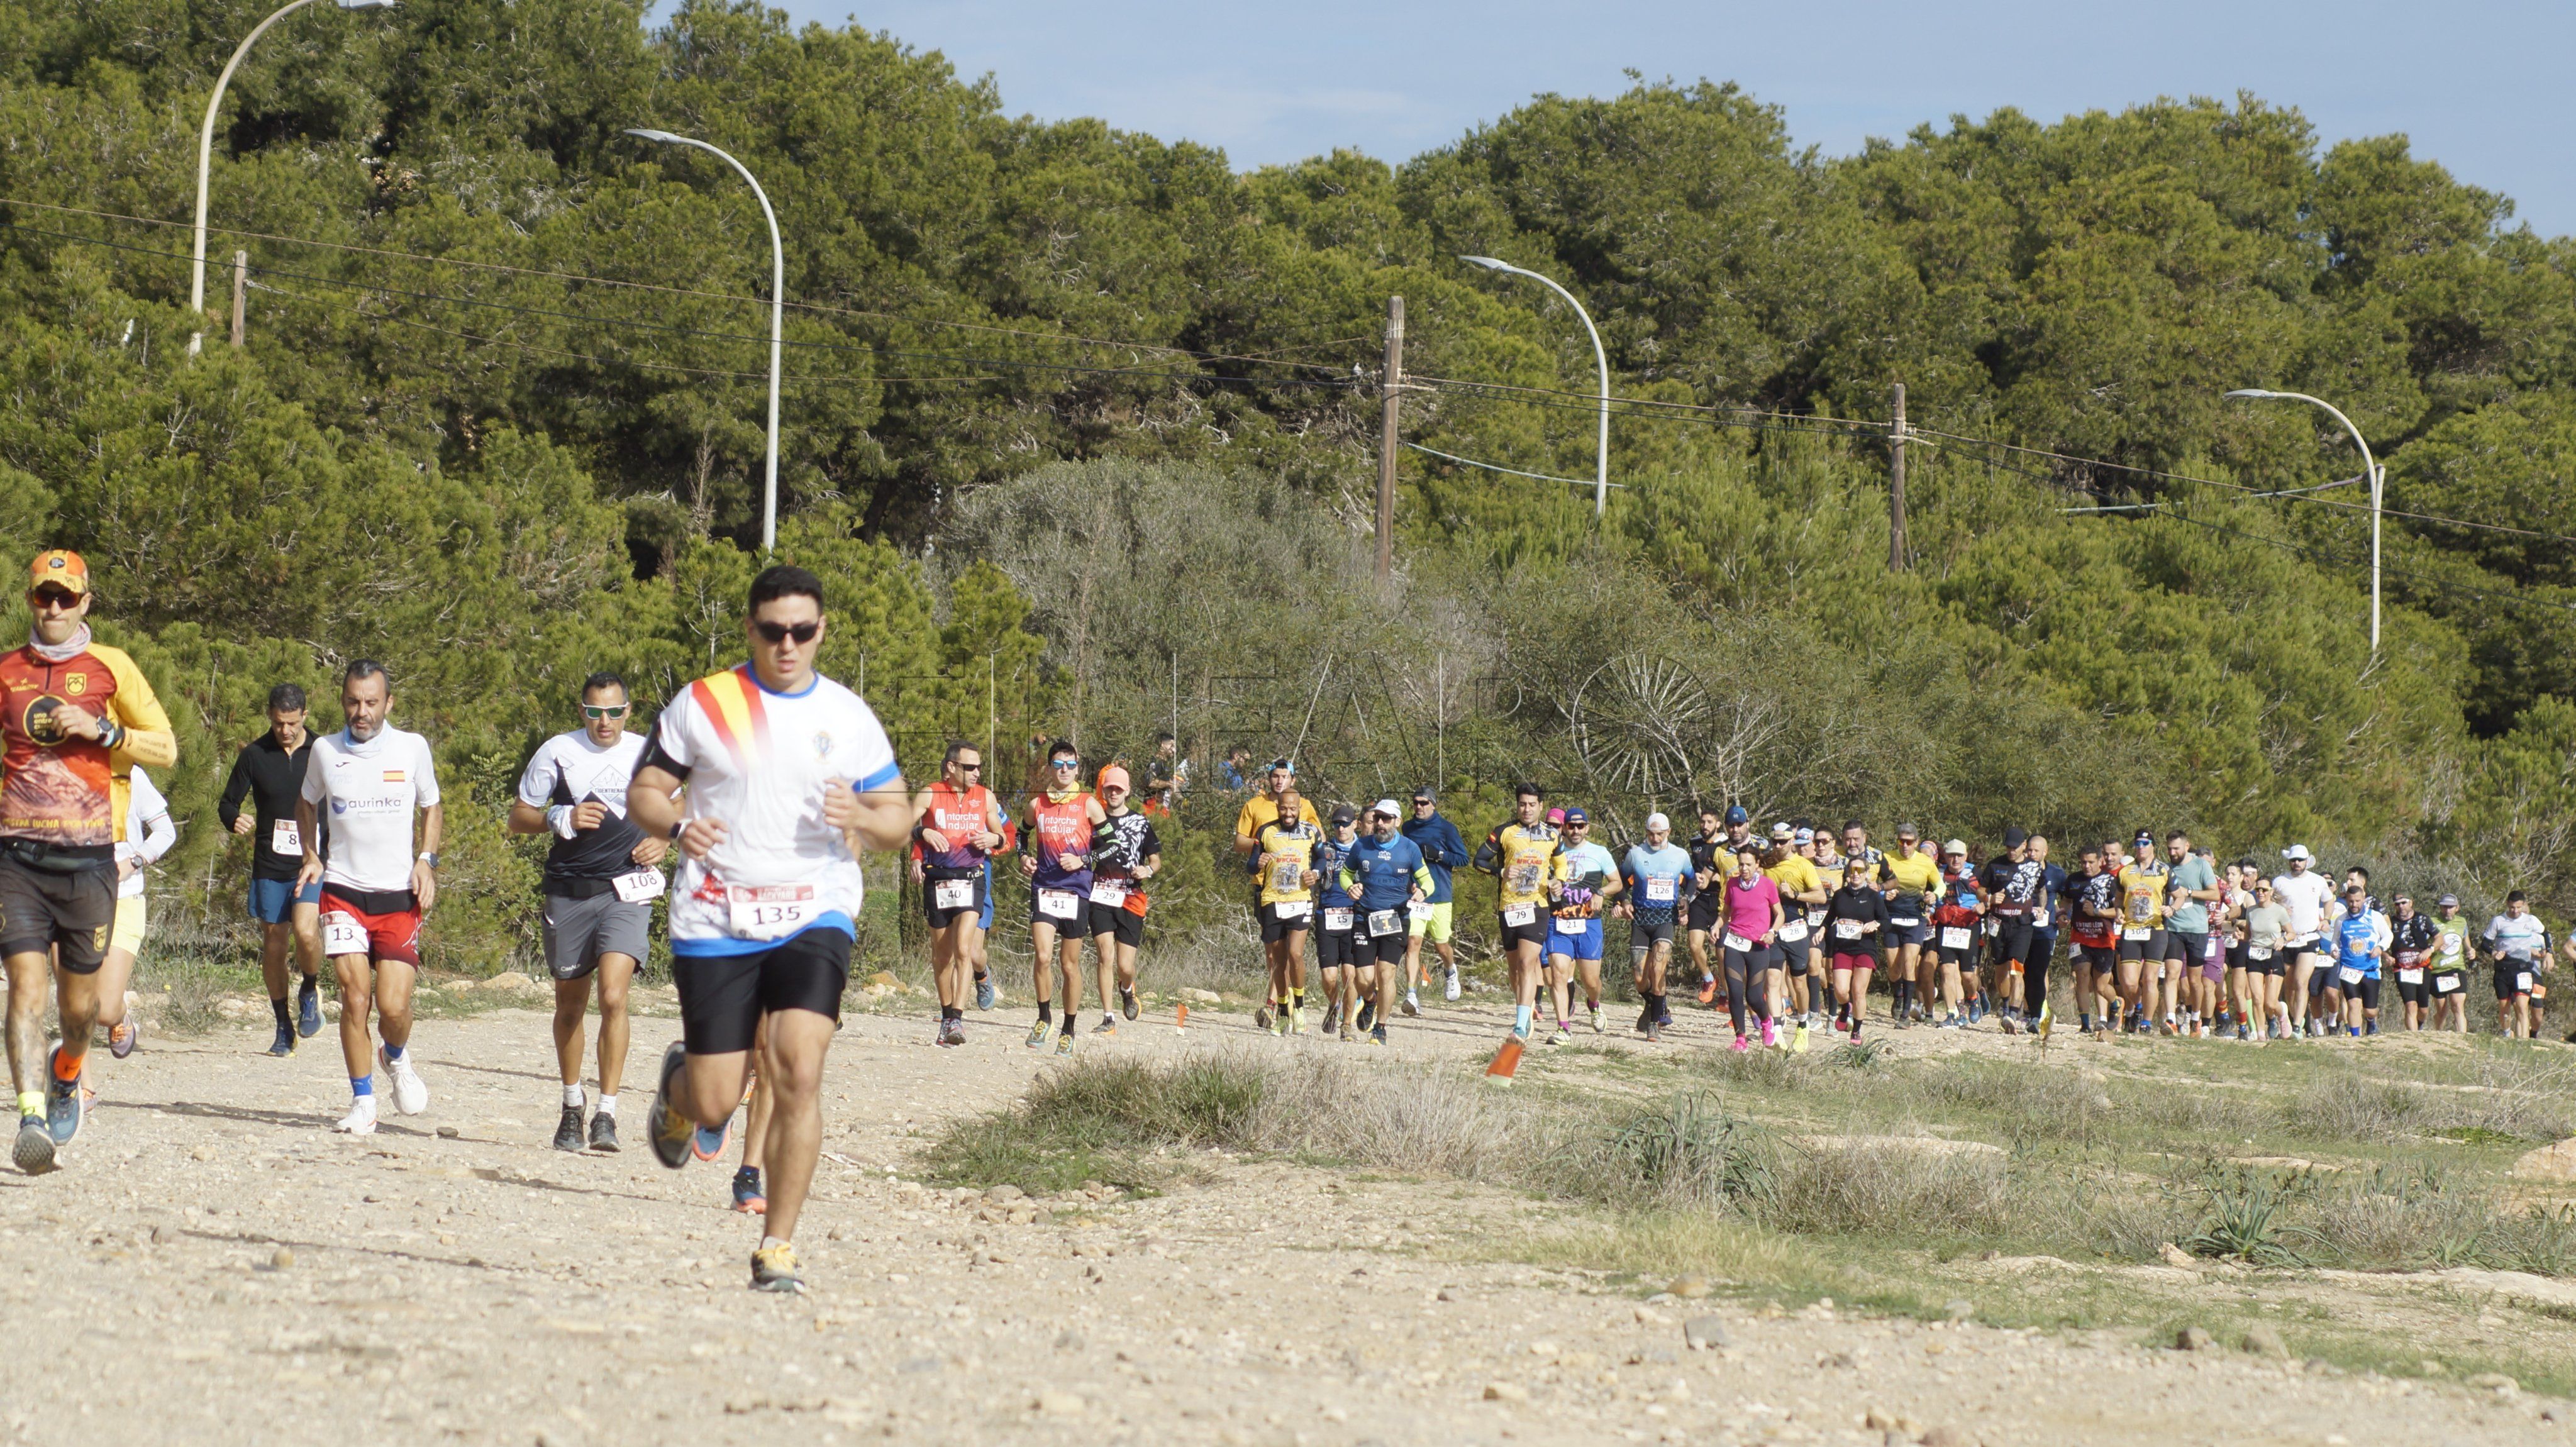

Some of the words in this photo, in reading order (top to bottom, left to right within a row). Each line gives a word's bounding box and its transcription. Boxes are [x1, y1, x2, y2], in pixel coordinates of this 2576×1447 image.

[348, 797, 401, 809] aurinka
[33, 818, 60, 828] LUCHA
[628, 873, 658, 889] 108
[948, 889, 961, 899] 40
[1102, 891, 1116, 900] 29
[1052, 899, 1065, 909] 41
[753, 906, 801, 926] 135
[1337, 915, 1348, 923] 15
[1515, 911, 1526, 919] 79
[1382, 918, 1392, 929] 1
[333, 928, 353, 941] 13
[1845, 926, 1855, 934] 96
